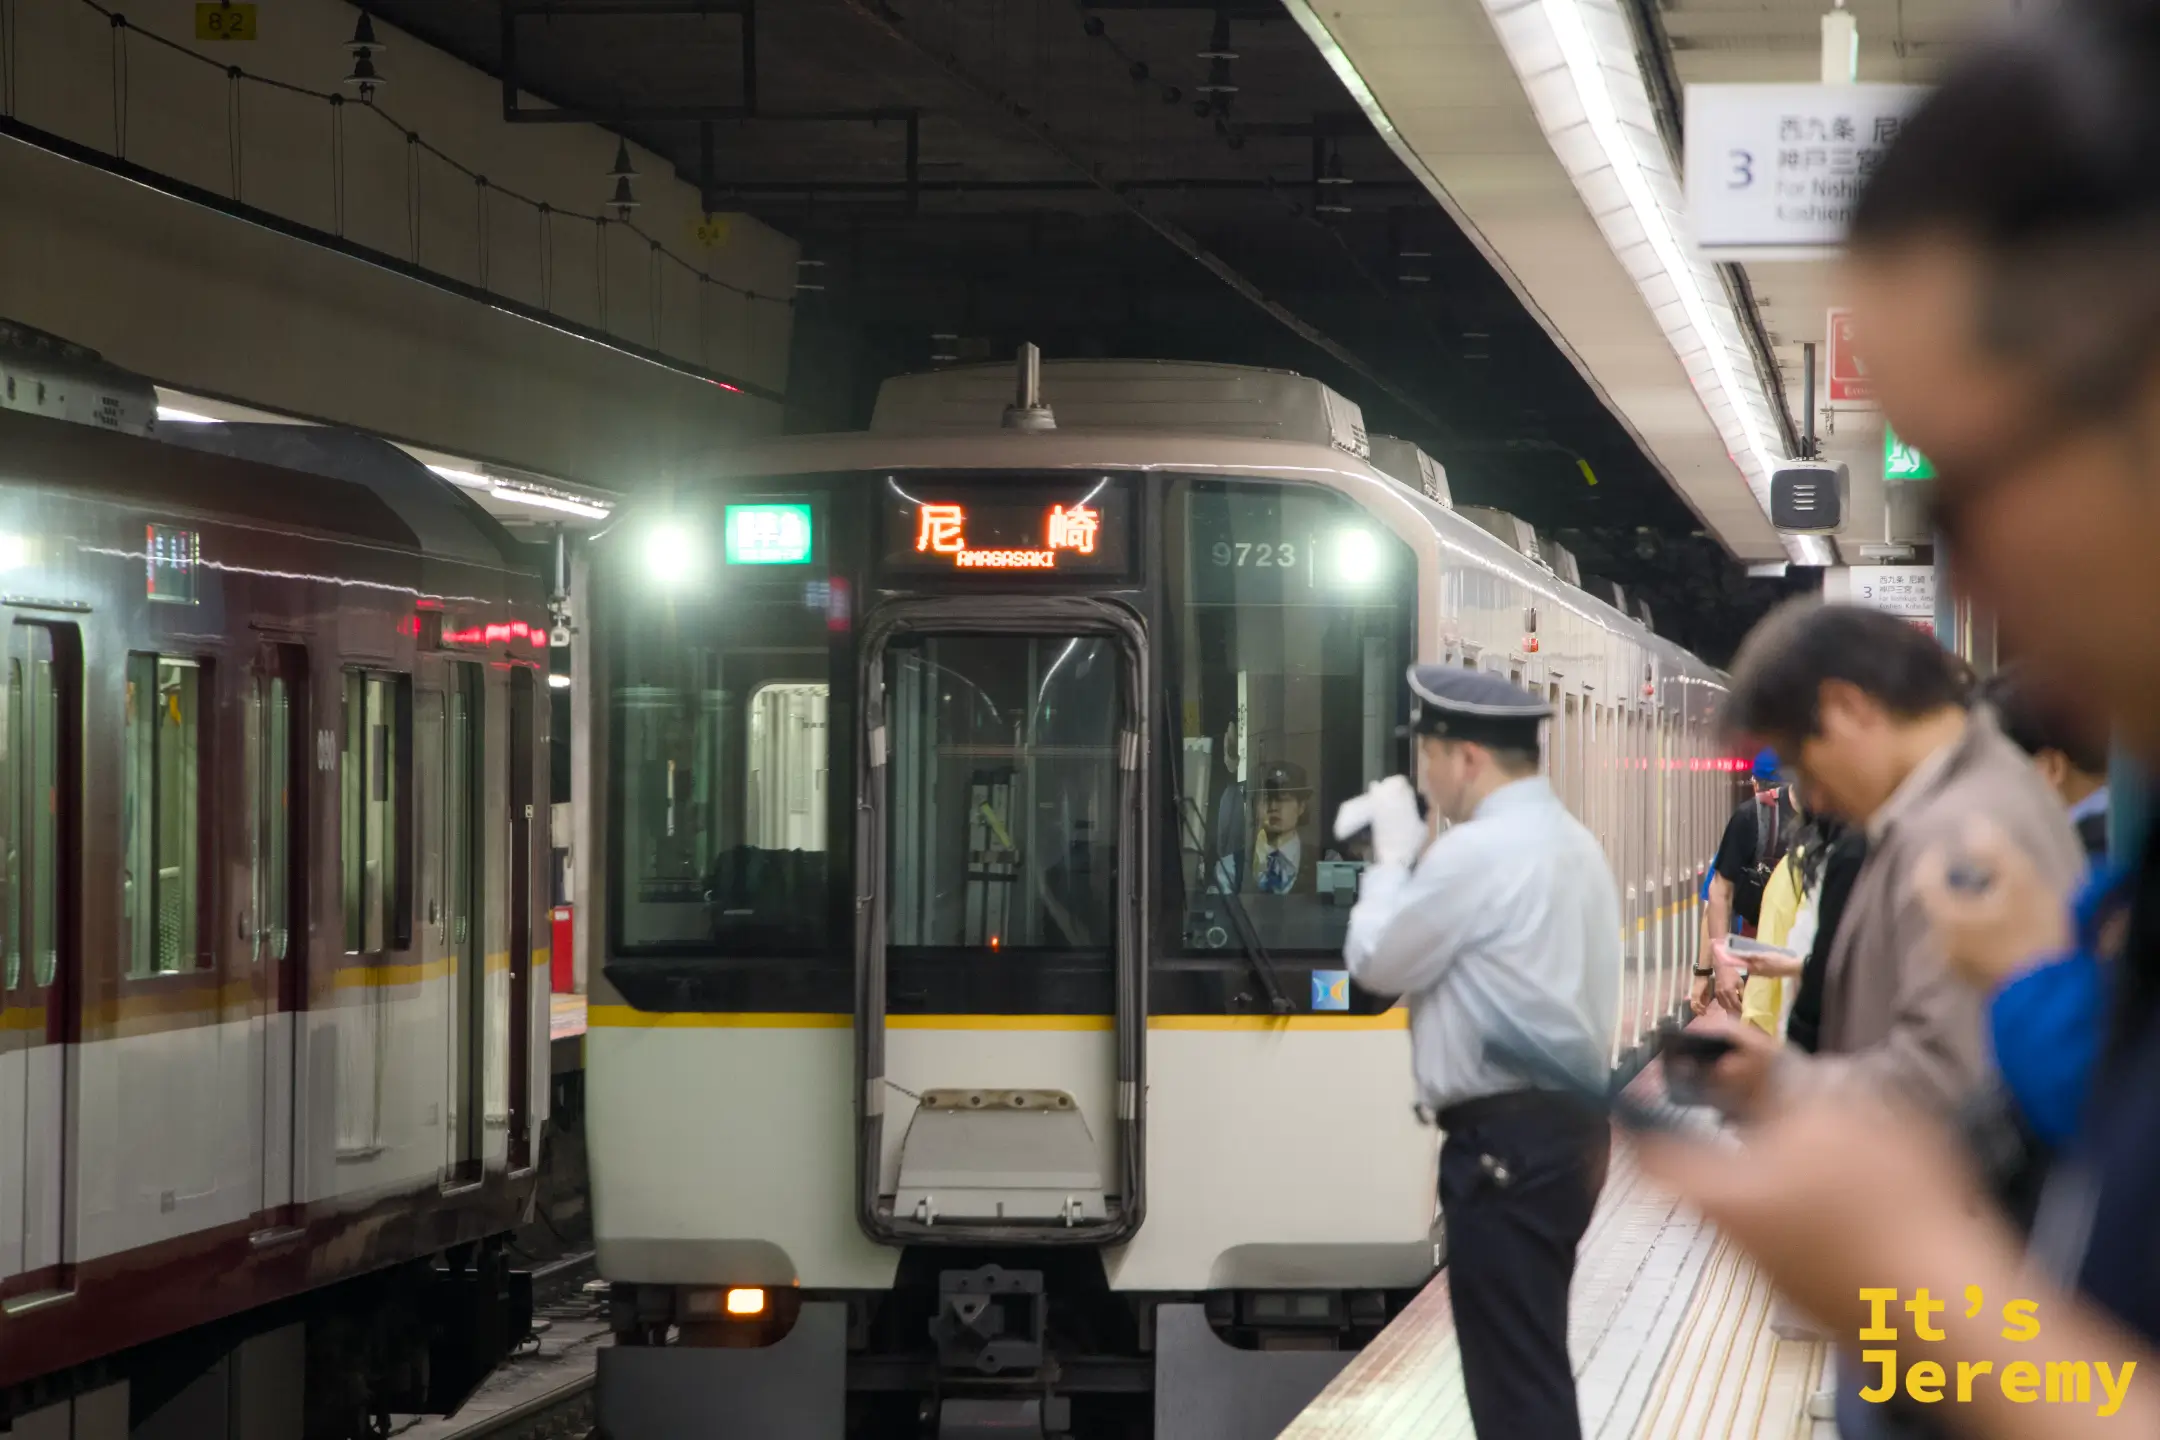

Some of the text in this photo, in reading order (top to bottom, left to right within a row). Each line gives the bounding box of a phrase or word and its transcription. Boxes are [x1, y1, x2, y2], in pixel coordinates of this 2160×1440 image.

[1727, 149, 1753, 190] 3
[956, 550, 1055, 567] AMAGASAKI
[1211, 542, 1296, 567] 9723
[1863, 586, 1873, 599] 3
